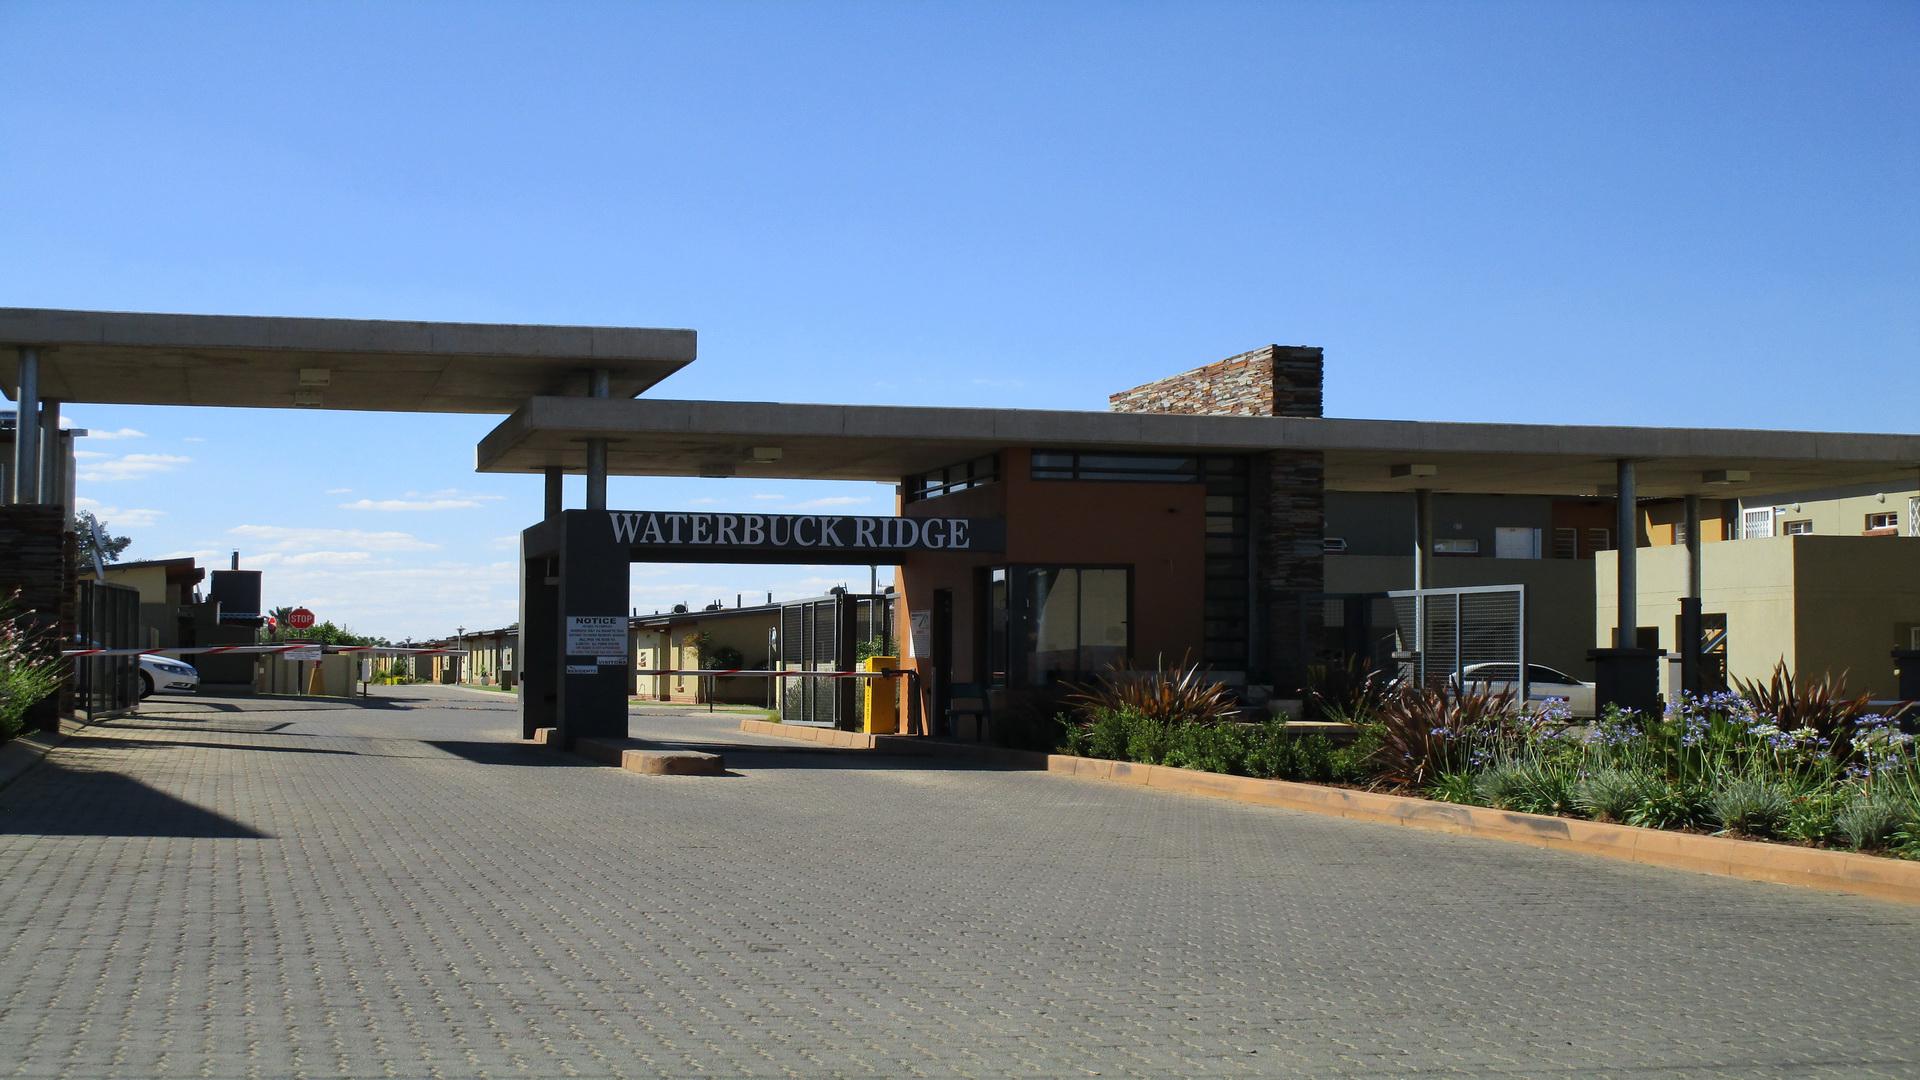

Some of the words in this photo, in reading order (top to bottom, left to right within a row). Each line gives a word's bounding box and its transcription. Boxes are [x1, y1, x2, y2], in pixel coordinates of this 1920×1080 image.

[609, 512, 847, 547] WATERBUCK
[853, 517, 970, 549] RIDGE
[291, 615, 312, 623] STOP
